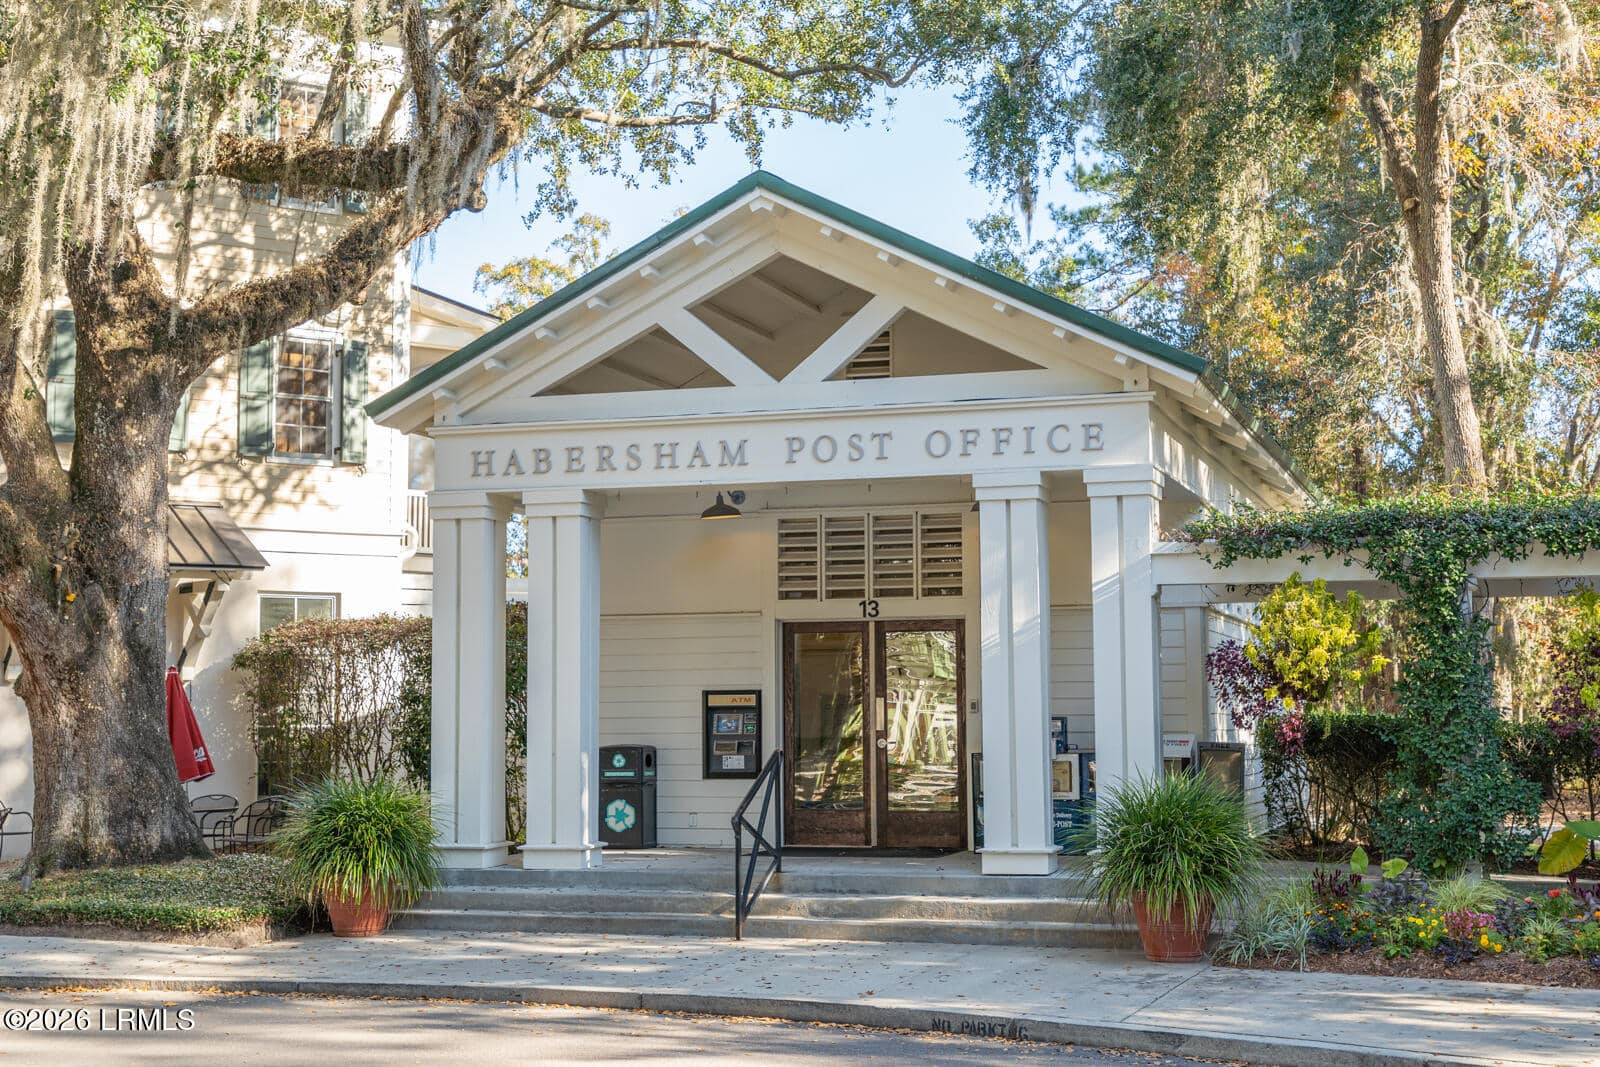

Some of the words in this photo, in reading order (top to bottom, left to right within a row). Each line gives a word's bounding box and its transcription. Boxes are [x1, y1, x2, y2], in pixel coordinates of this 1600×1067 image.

[471, 439, 749, 478] HABERSHAM
[784, 431, 893, 464] POST
[924, 423, 1105, 459] OFFICE
[858, 600, 880, 618] 13
